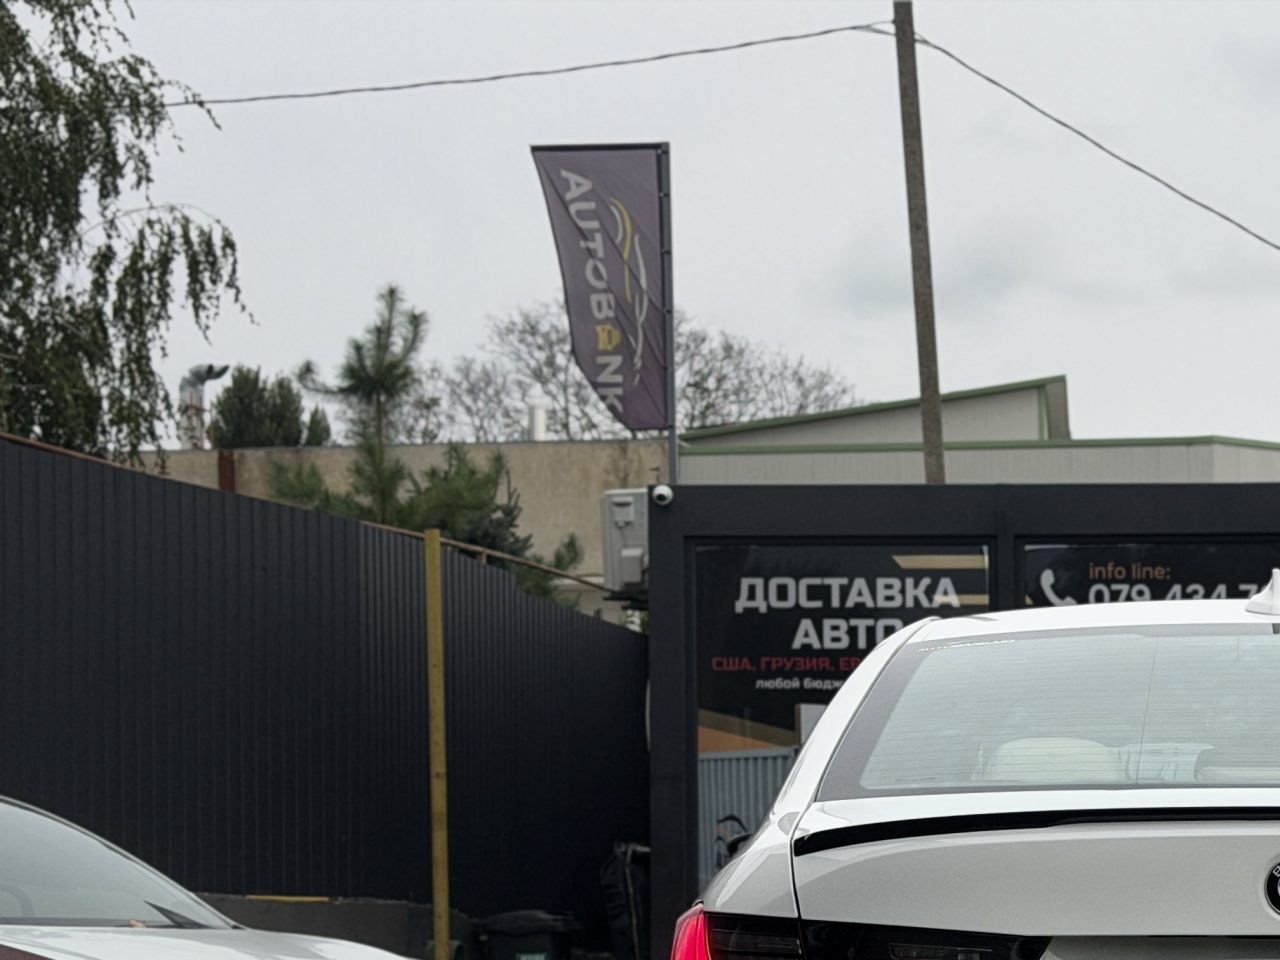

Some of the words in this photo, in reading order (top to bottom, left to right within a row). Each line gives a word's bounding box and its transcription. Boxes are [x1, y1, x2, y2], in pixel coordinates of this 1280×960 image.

[1089, 563, 1126, 580] info
[1132, 562, 1171, 580] line:
[735, 577, 961, 613] ДОСТАВКА
[1088, 583, 1152, 604] 079
[791, 618, 904, 650] АВТО
[755, 677, 800, 690] любой
[803, 678, 845, 691] бюдж
